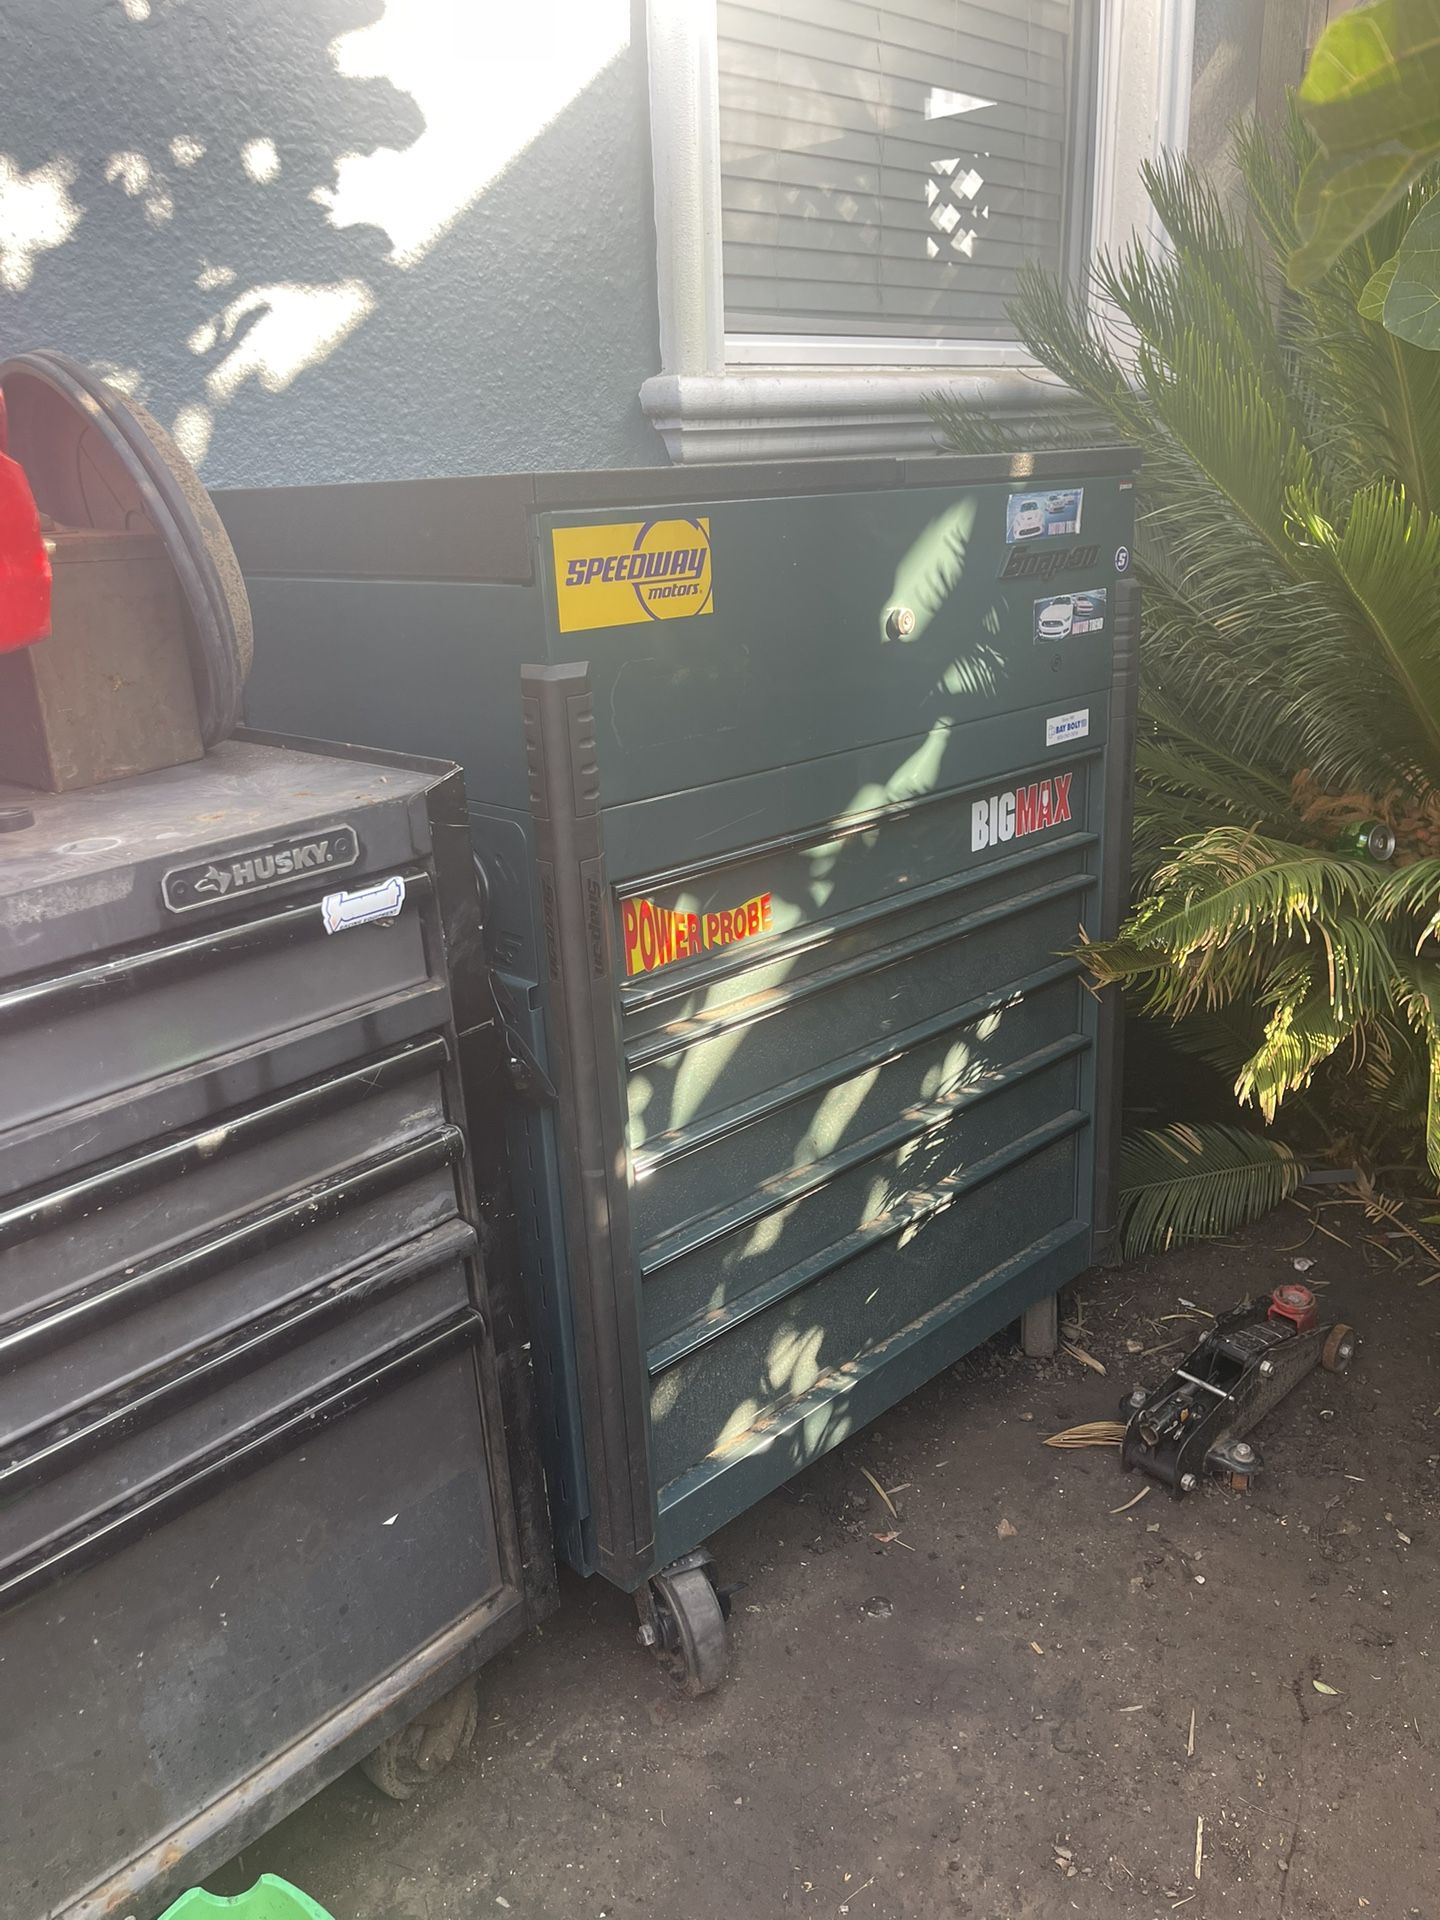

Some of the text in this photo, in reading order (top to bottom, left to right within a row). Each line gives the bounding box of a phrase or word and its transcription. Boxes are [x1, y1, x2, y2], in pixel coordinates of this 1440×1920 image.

[566, 547, 708, 586] SPEEDWAY
[648, 583, 700, 600] motors
[1056, 724, 1067, 734] BAY
[1067, 720, 1081, 731] BOLT
[232, 841, 329, 885] HUSKY
[622, 898, 702, 977] POWER
[704, 892, 774, 951] PROBE
